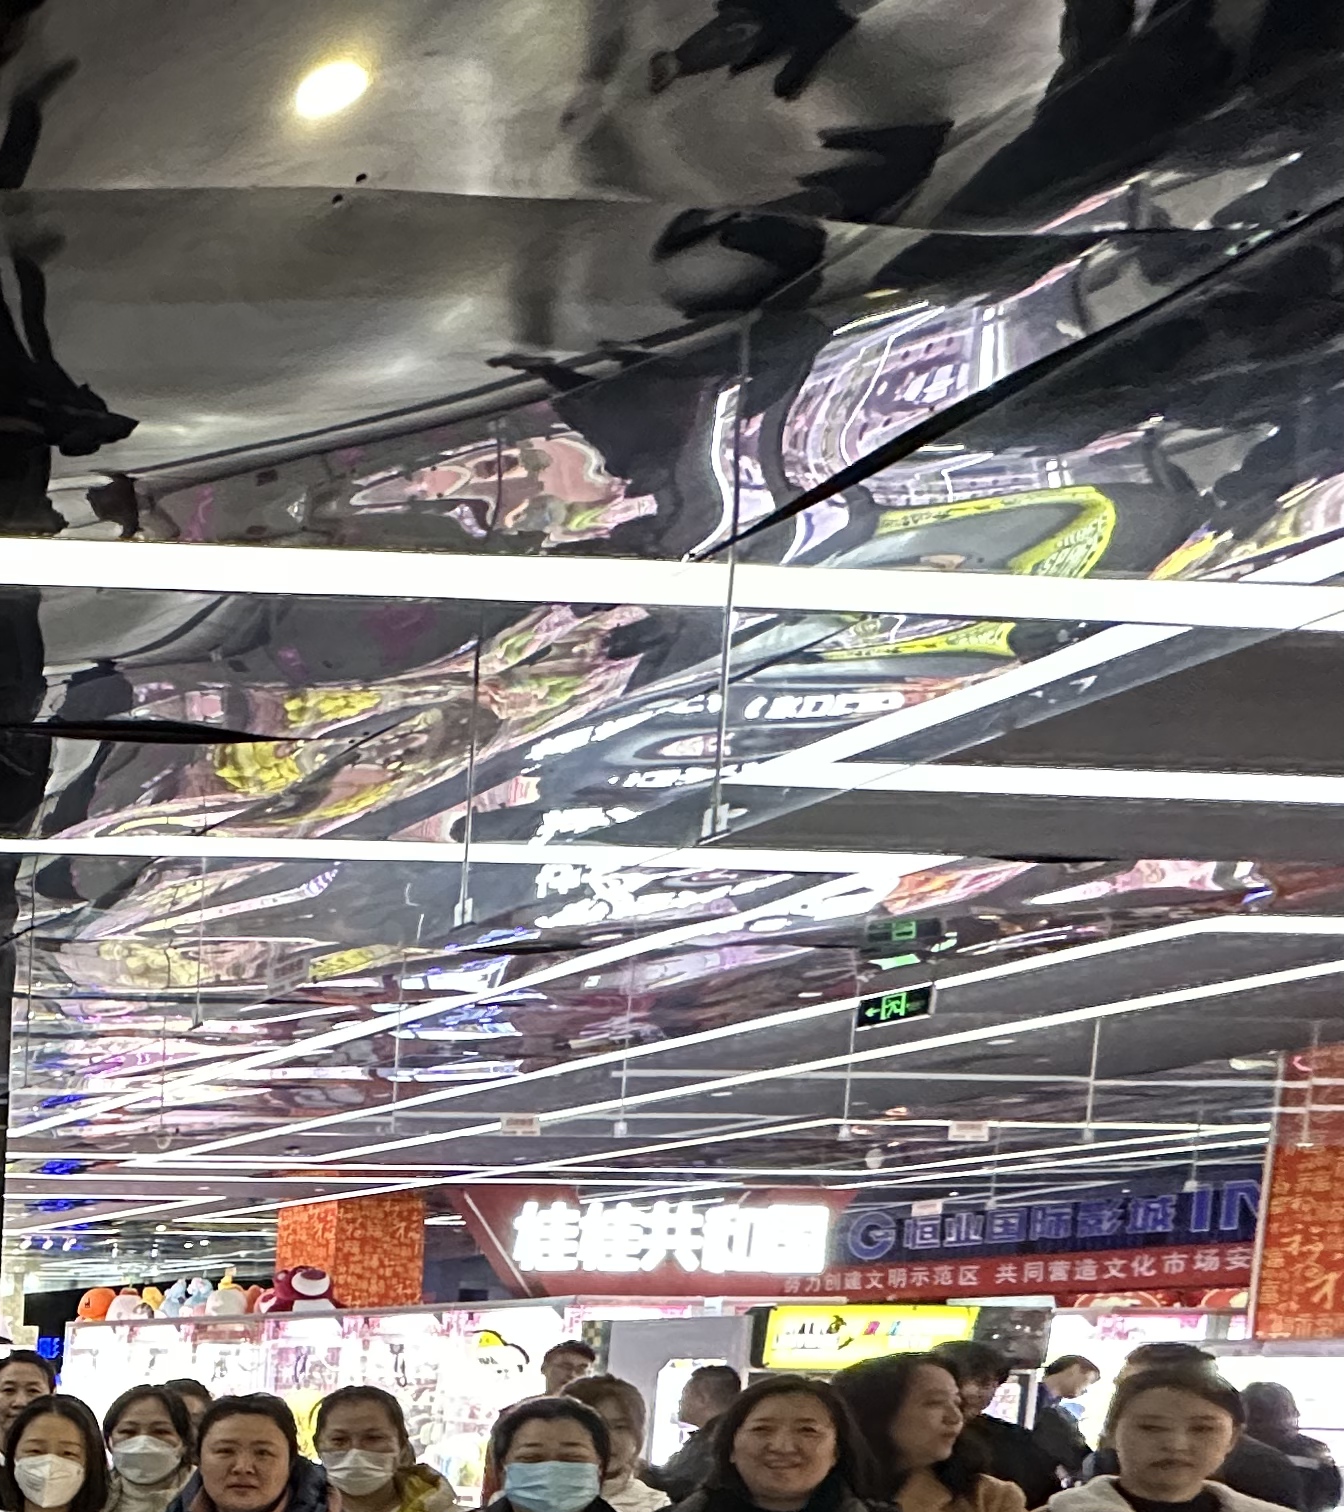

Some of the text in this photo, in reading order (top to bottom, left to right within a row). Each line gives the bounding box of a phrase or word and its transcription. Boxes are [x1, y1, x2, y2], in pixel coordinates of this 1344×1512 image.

[903, 1195, 1177, 1250] 恒业国际影城
[784, 1264, 981, 1293] 努力创建文明示范区
